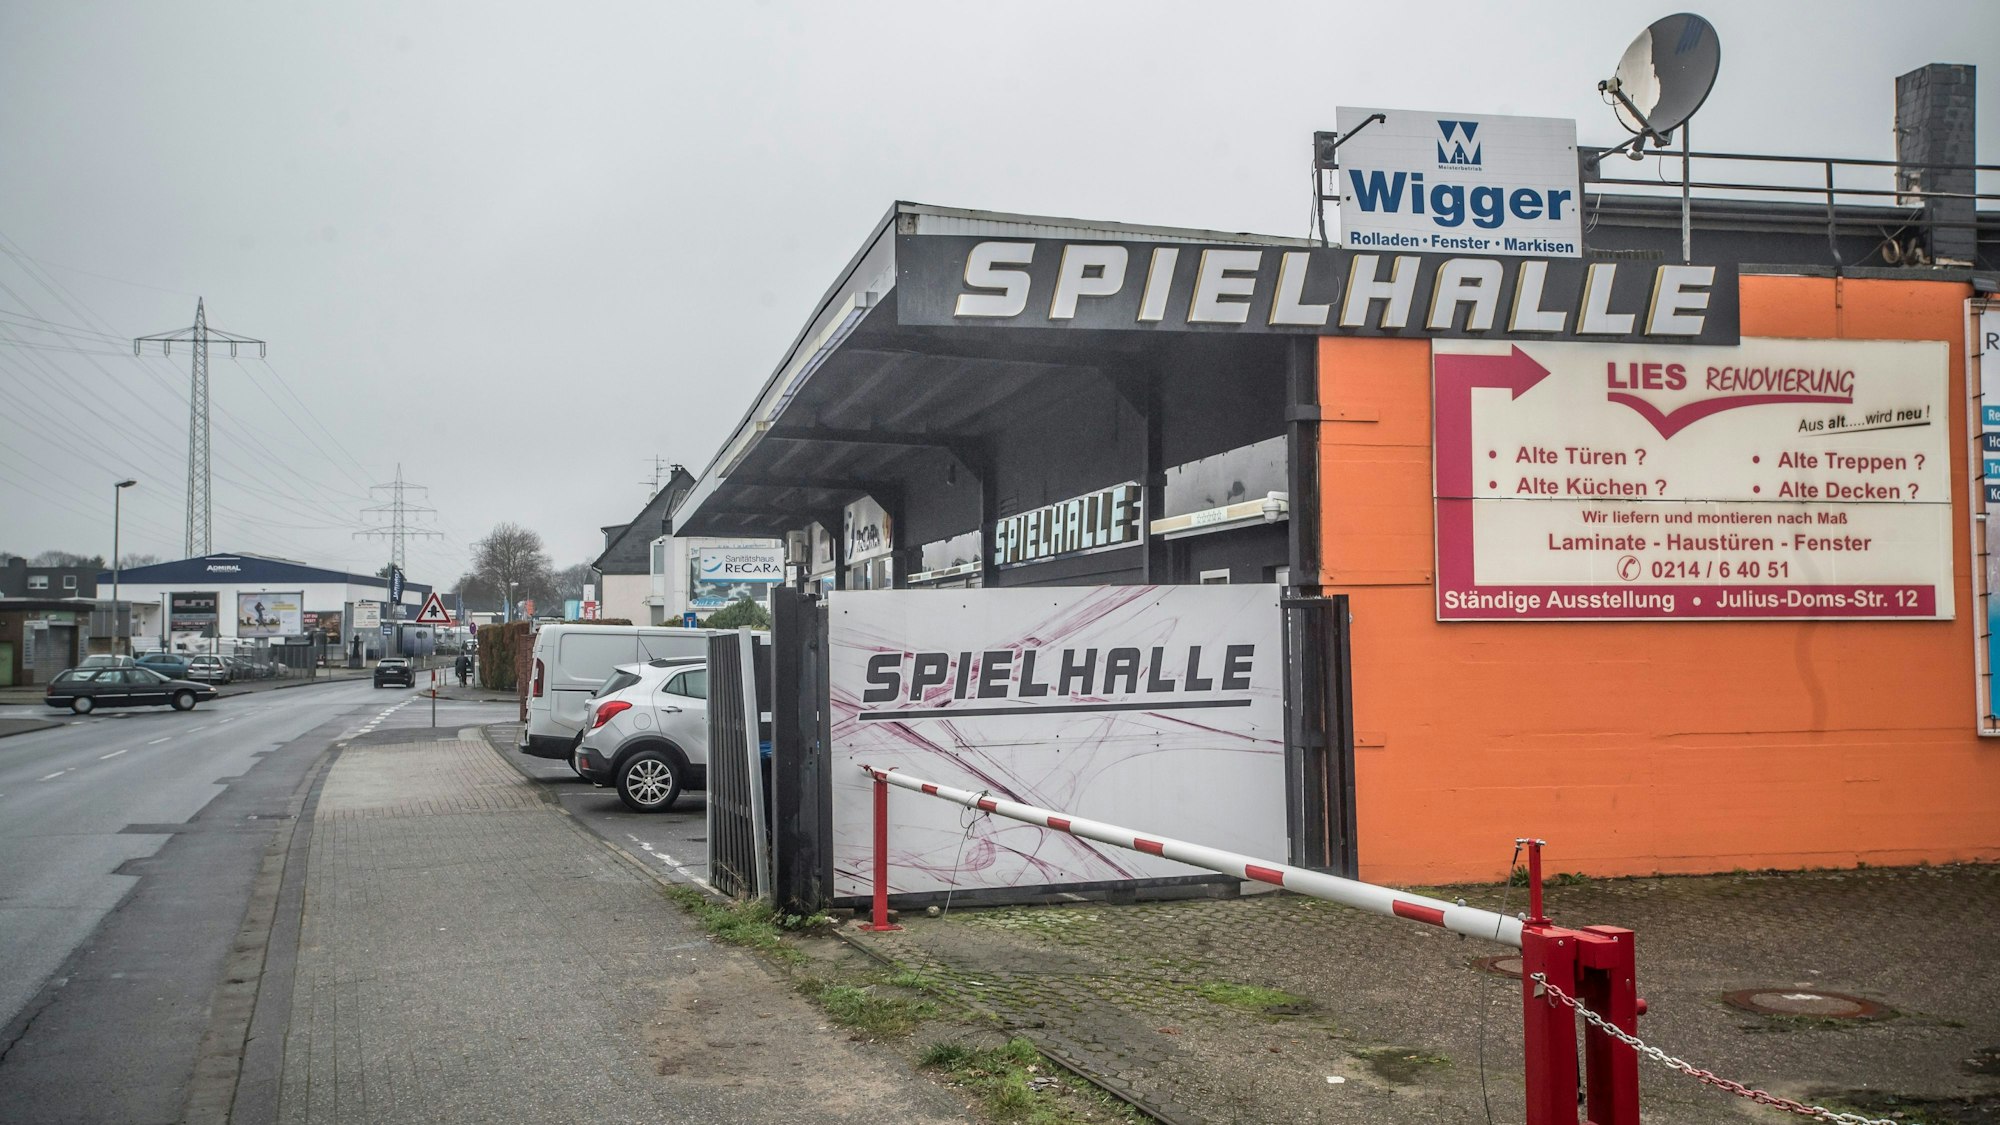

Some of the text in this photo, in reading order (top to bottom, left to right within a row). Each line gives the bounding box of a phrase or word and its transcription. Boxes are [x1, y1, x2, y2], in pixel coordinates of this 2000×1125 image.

[1349, 169, 1571, 229] Wigger
[1350, 231, 1574, 253] Rolladen Fenster Markisen
[954, 241, 1716, 336] SPIELHALLE
[1607, 362, 1855, 397] LIES RENOVIERUNG
[1798, 418, 1824, 433] Aus
[1896, 409, 1922, 422] neu
[1516, 446, 1558, 464] Alte
[1565, 447, 1626, 465] Türen
[1778, 452, 1818, 468] Alte
[1825, 452, 1907, 473] Treppen
[1516, 477, 1559, 495] Alte
[1566, 477, 1647, 496] Küchen
[1778, 481, 1819, 498] Alte
[1826, 482, 1900, 499] Decken
[994, 485, 1144, 566] SPIELHALLE
[1582, 511, 1848, 525] Wir liefern und montieren nach Maß
[1548, 533, 1646, 550] Laminate
[1667, 534, 1774, 551] Haustüren
[1794, 534, 1872, 551] Fenster
[1652, 561, 1700, 578] 0214
[1719, 562, 1730, 578] 6
[1737, 562, 1760, 578] 40
[1768, 561, 1789, 578] 51
[1445, 590, 1675, 613] Ständige Ausstellung
[1716, 589, 1918, 608] Julius-Doms-Str. 12
[863, 644, 1255, 703] SPIELHALLE
